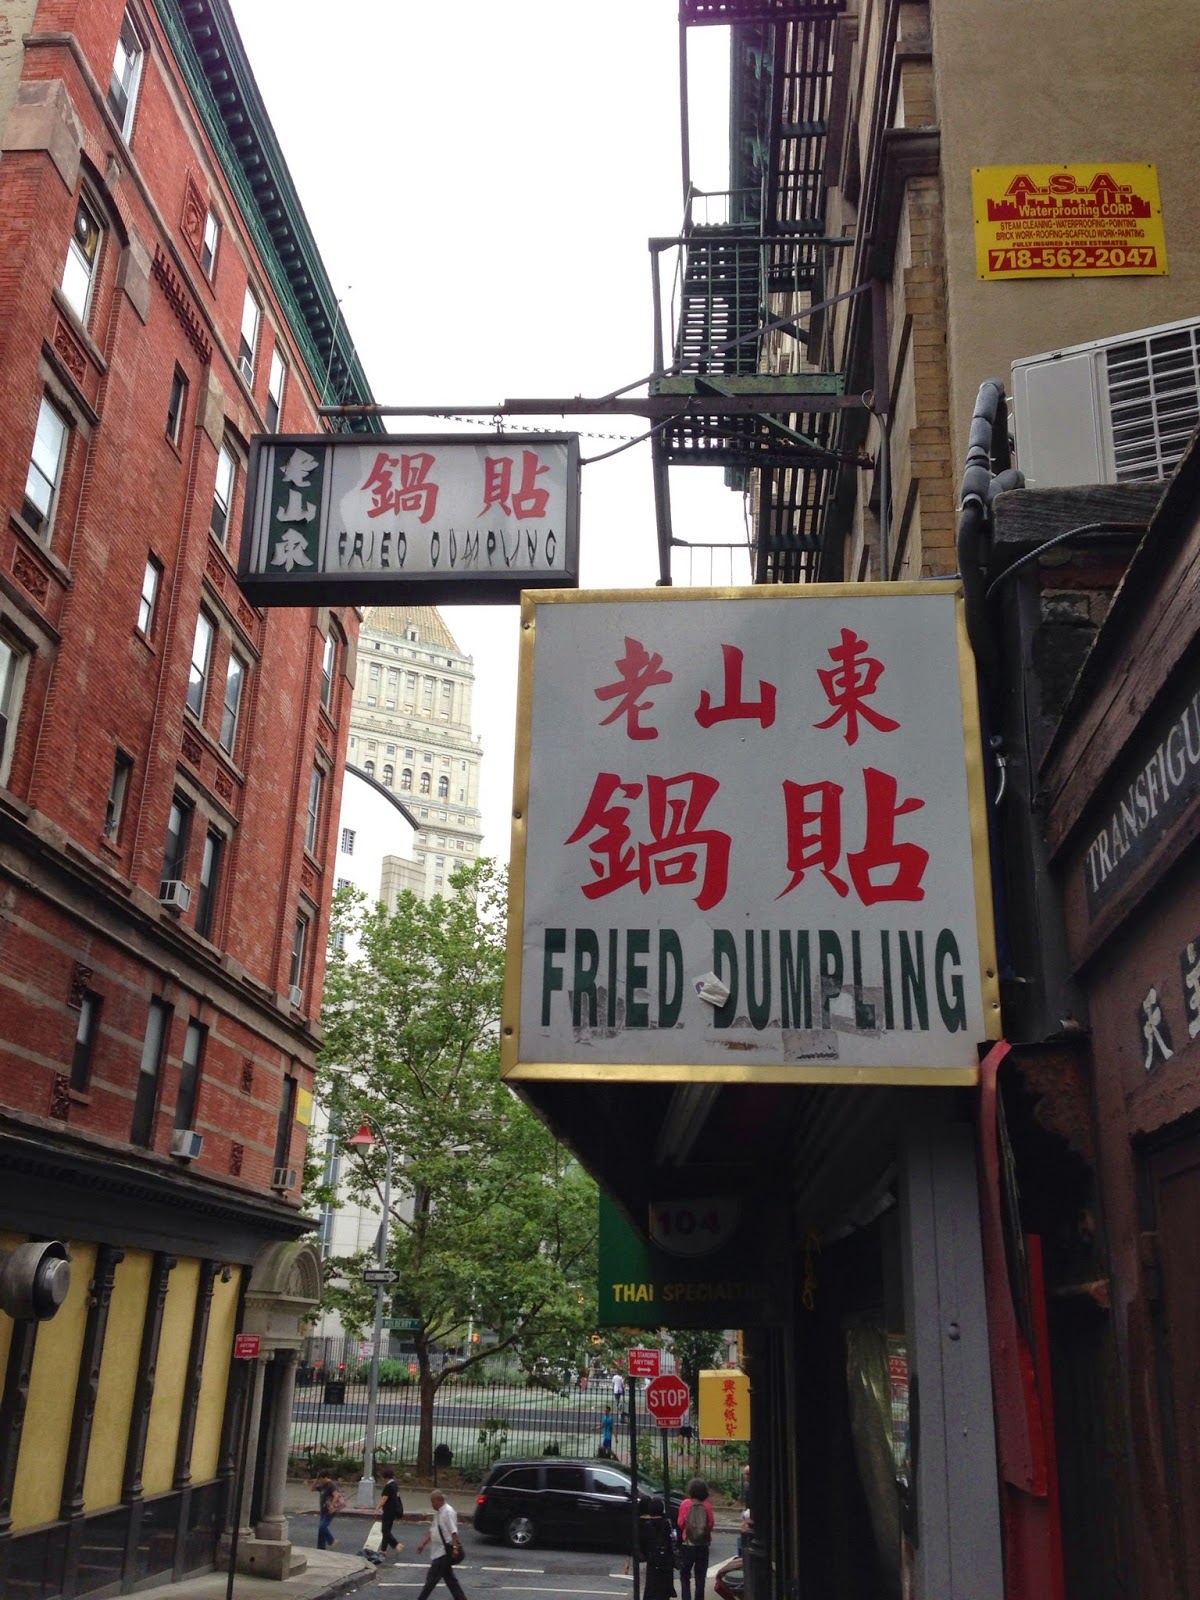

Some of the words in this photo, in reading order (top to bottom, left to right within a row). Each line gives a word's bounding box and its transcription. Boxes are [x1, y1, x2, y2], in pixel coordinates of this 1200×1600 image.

[1004, 173, 1133, 197] A.S.A.
[1018, 204, 1100, 218] Waterproofing
[1101, 203, 1135, 216] CORP.
[996, 231, 1014, 241] BRICK
[1015, 230, 1034, 240] WORK
[1035, 230, 1063, 240] ROOFING
[1065, 229, 1098, 239] SCAFFOLD
[1098, 229, 1115, 238] WORK
[1117, 228, 1145, 238] PAINTING
[1000, 221, 1021, 231] STEAM
[1022, 220, 1052, 230] CLEANING
[991, 247, 1153, 269] 718-562-2047
[360, 449, 551, 524] 鍋貼
[593, 627, 901, 746] 老山東
[563, 766, 930, 911] 鍋貼
[540, 927, 685, 1030] FRIED
[711, 927, 968, 1033] DUMPLING
[657, 1207, 721, 1237] 104
[612, 1283, 654, 1303] THAI
[649, 1389, 687, 1408] STOP
